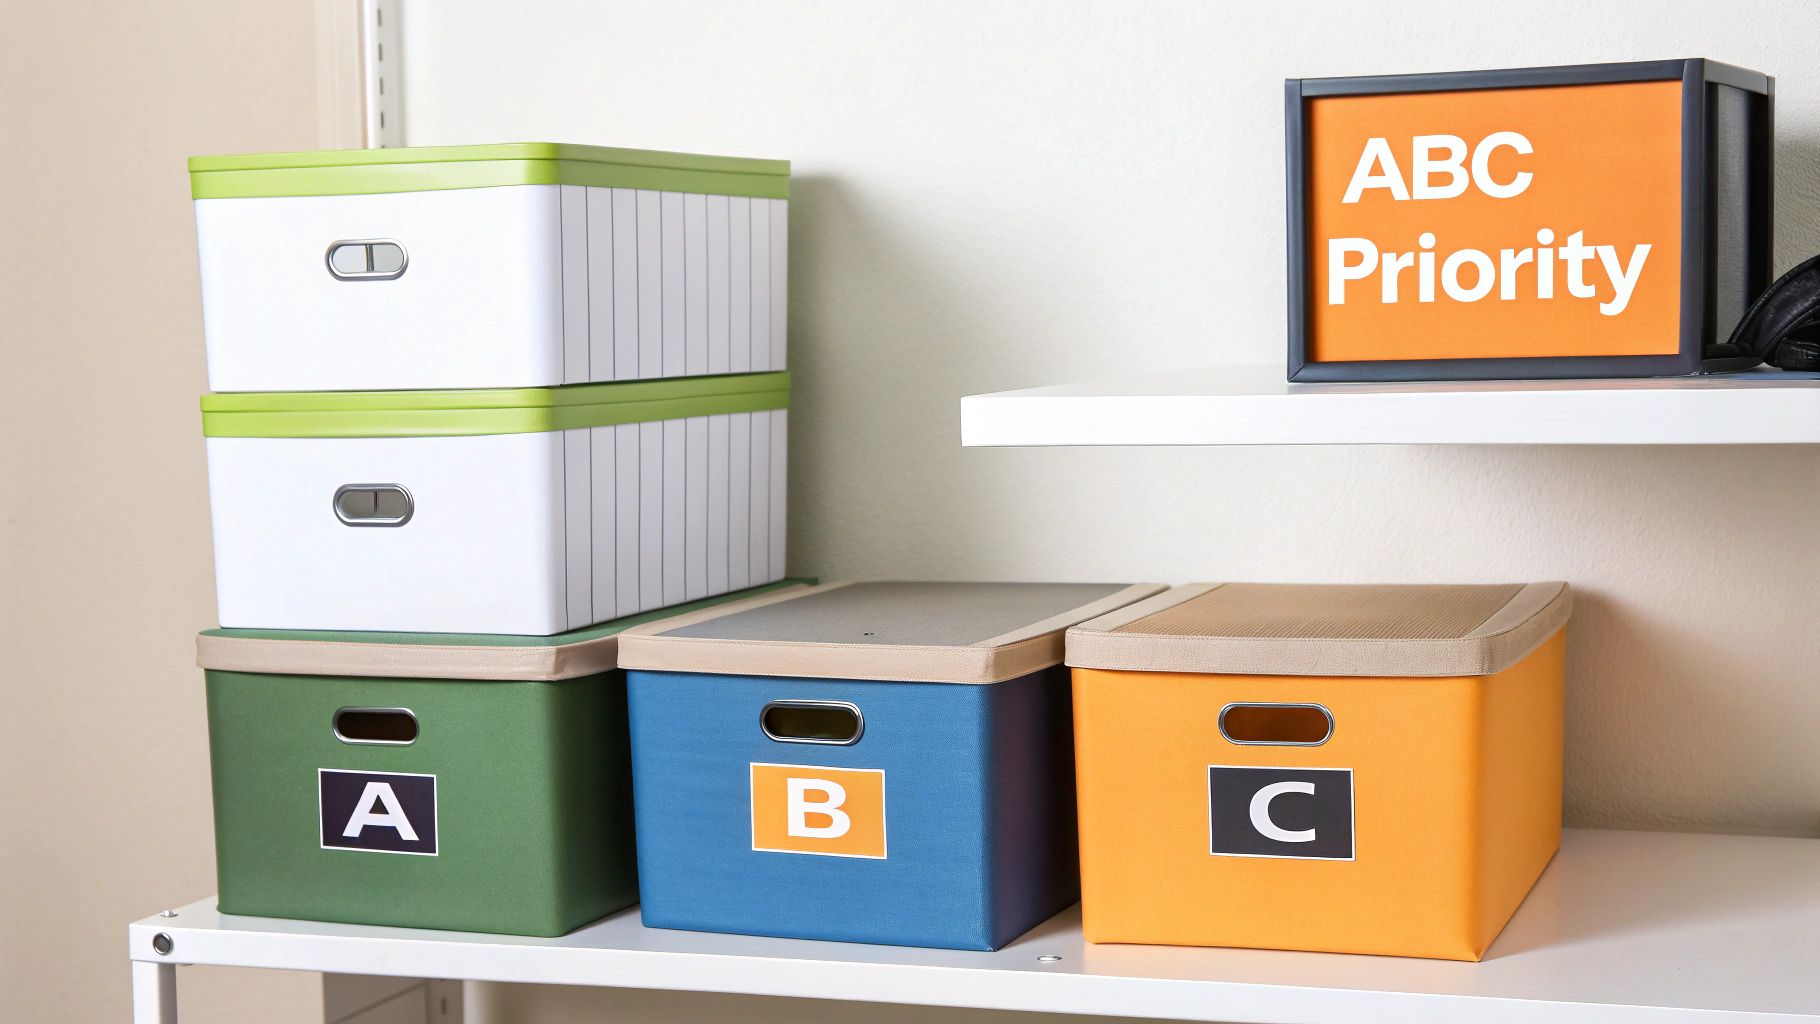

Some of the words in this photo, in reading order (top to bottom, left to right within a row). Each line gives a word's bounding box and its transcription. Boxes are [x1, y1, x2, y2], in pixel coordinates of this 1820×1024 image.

[1342, 131, 1533, 204] ABC
[1328, 228, 1652, 316] Priority
[342, 781, 420, 841] A
[786, 777, 851, 839] B
[1248, 781, 1316, 843] C
